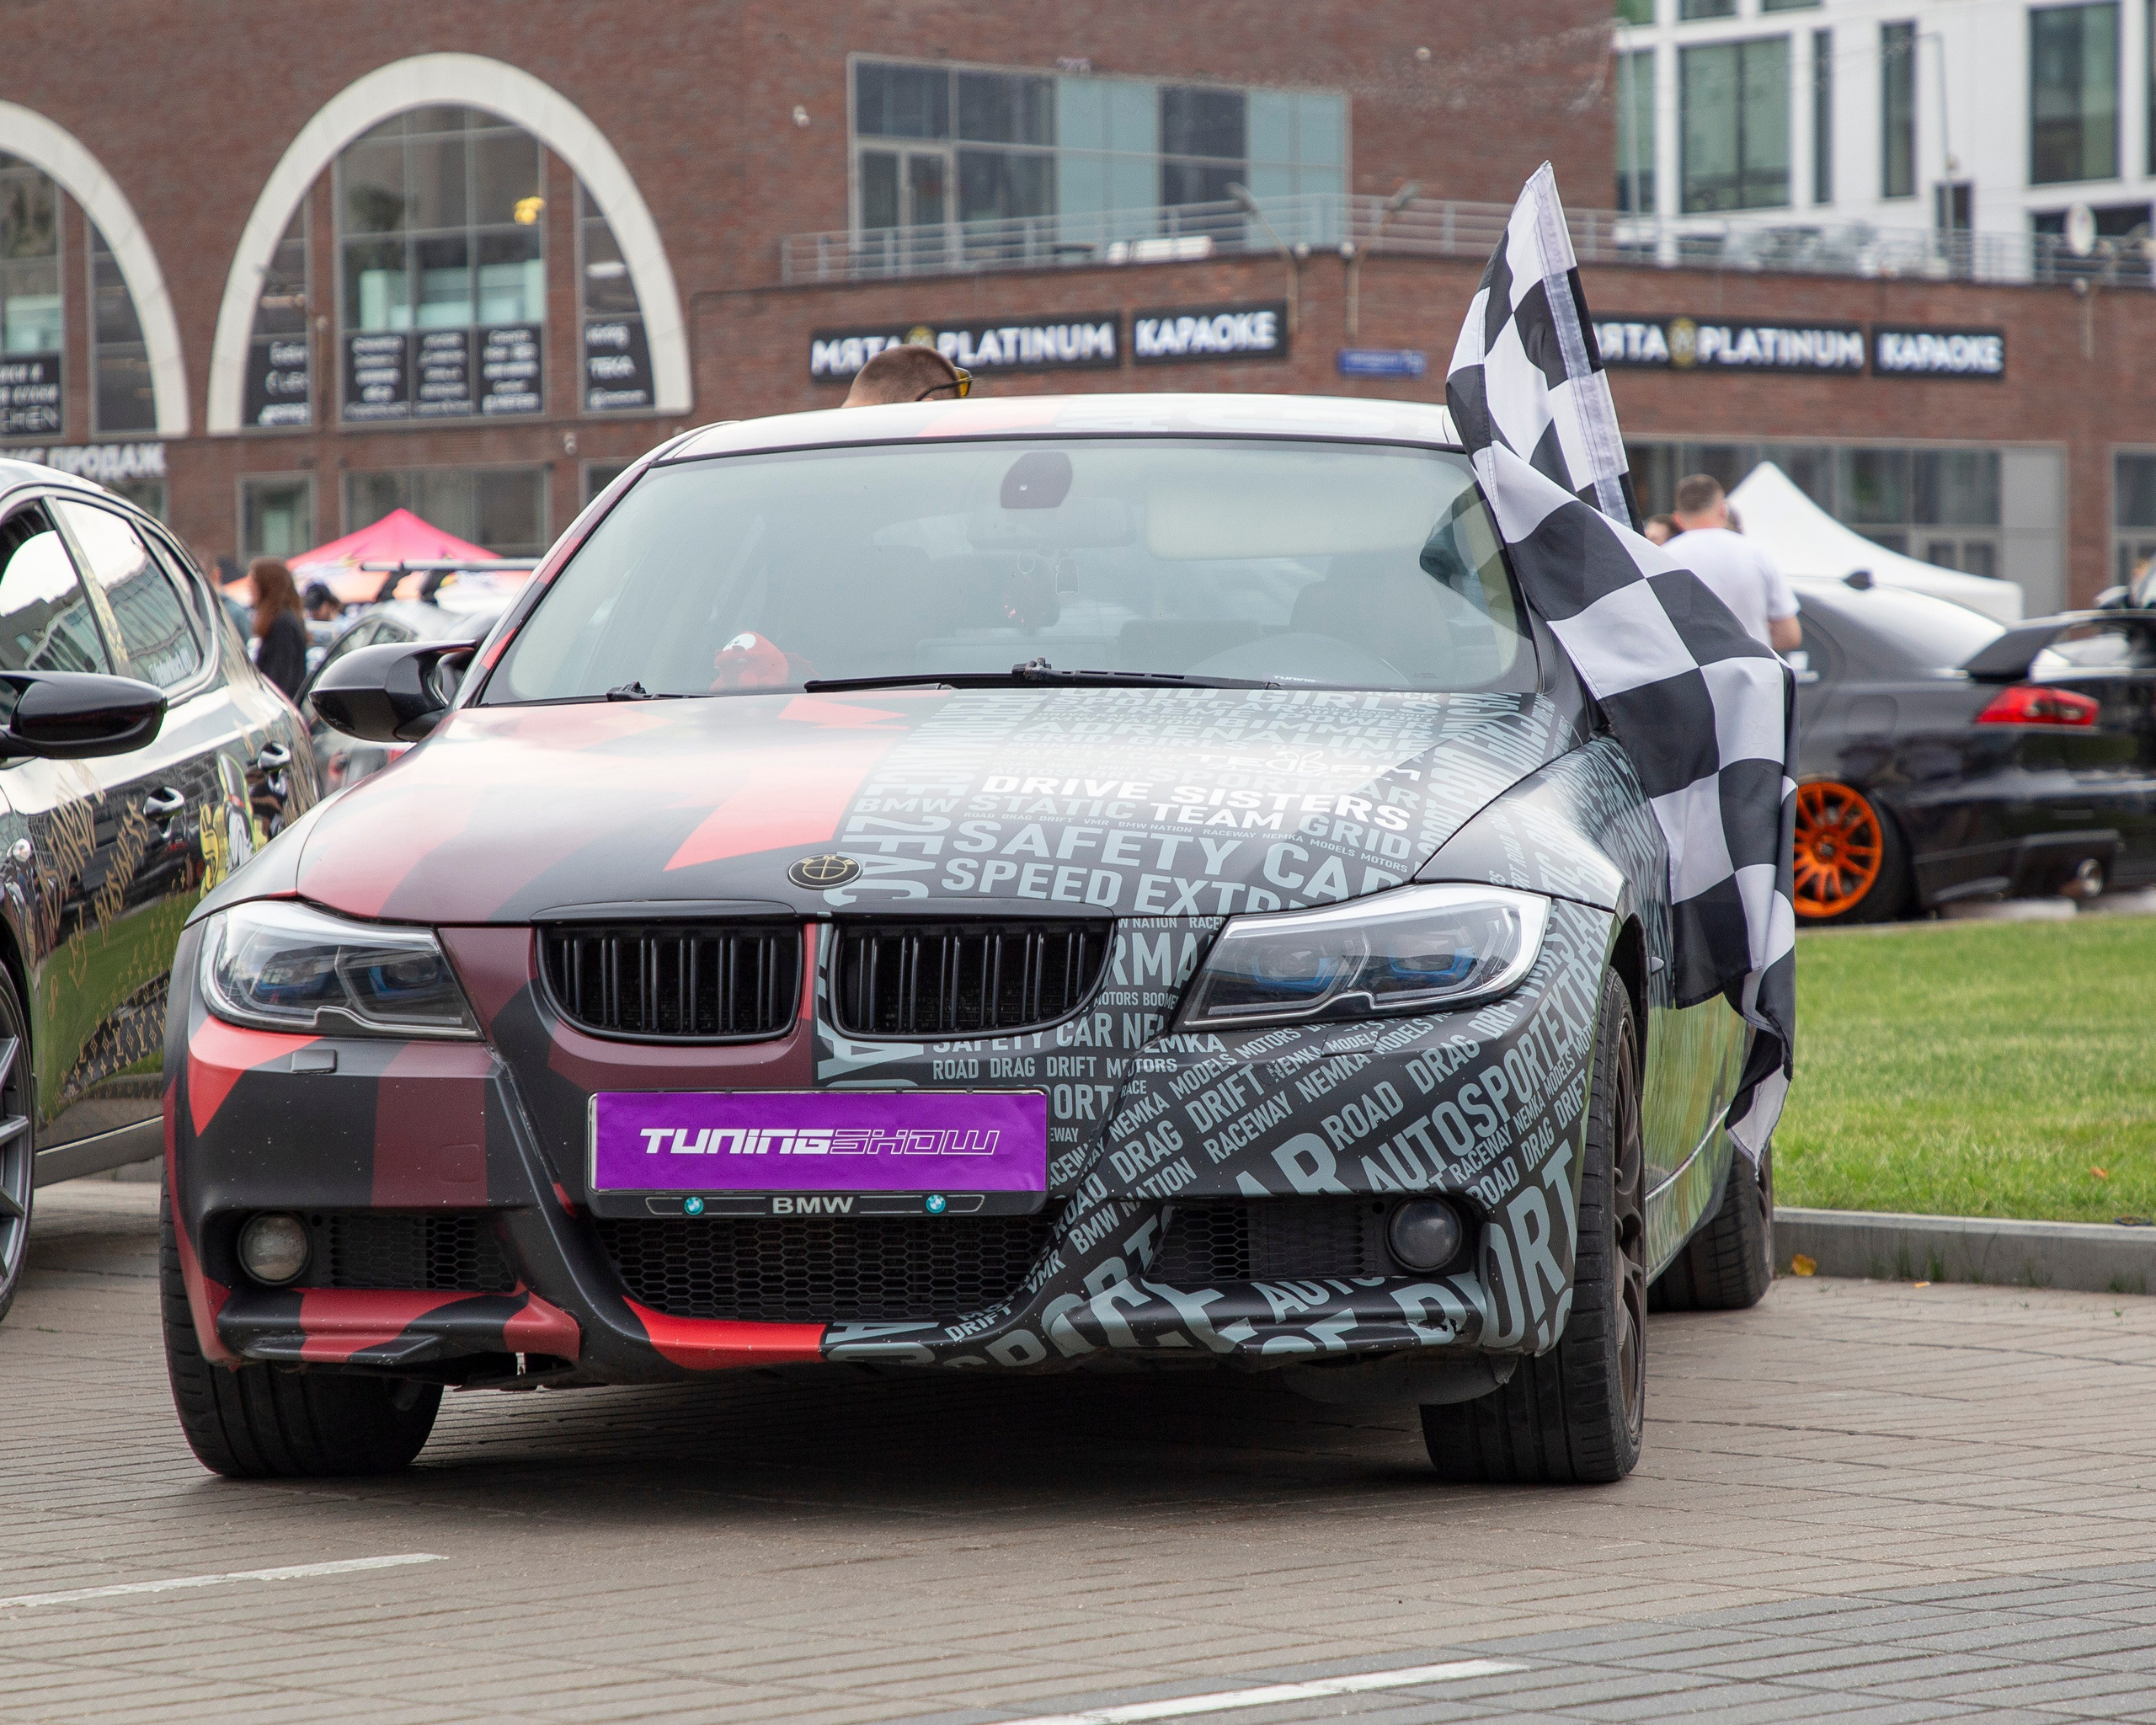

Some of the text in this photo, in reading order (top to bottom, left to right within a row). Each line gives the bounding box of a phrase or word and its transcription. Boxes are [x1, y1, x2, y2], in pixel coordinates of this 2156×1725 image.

[937, 323, 1116, 367] PLATINUM
[1136, 311, 1278, 356] КАРАОКЕ
[1697, 325, 1865, 370] PLATINUM
[1879, 333, 2003, 372] КАРАОКЕ
[47, 442, 166, 482] ПРОДАЖ
[1043, 704, 1433, 729] EXTREME POWER
[1051, 697, 1298, 713] SPORTCAR
[1246, 689, 1442, 715] GIRLS
[1353, 692, 1440, 702] RACK
[1021, 722, 1434, 751] ADRENALINE
[1106, 717, 1202, 725] NATION
[1214, 718, 1433, 739] BIMMER
[1012, 733, 1113, 745] GRID
[1128, 735, 1250, 751] GIRLS
[981, 775, 1411, 831] DRIVE SISTERS
[988, 766, 1139, 781] AUTOSPORT
[1145, 767, 1421, 809] SPORTCAR
[852, 794, 1410, 860] BMW STATIC TEAM GRID
[1083, 818, 1109, 826] VMR
[1118, 820, 1147, 830] BMW
[1150, 824, 1193, 833] NATION
[1203, 828, 1257, 839] RACEWAY
[1262, 833, 1304, 843] NEMKA
[1310, 839, 1356, 857] MODELS
[1361, 852, 1408, 873] MOTORS
[953, 820, 1243, 875] SAFETY
[941, 858, 1308, 916] SPEED EXTR
[1132, 917, 1177, 928] NATION
[1189, 916, 1225, 930] RACE
[1094, 991, 1179, 1009] MOTORS BOOME
[1055, 1012, 1113, 1049] CAR
[1326, 1030, 1380, 1053] MODELS
[1373, 1017, 1435, 1055] MODELS
[933, 1055, 1177, 1079] ROAD DRAG DRIFT MOTORS
[1169, 1027, 1301, 1101] MODELS MOTORS
[1267, 1044, 1326, 1083] NEMKA
[1321, 998, 1524, 1151] ROAD DRAG DRIFT
[1121, 1080, 1147, 1097] RACE
[1203, 1053, 1372, 1164] RACEWAY NEMKA
[1361, 1014, 1554, 1193] AUTOSPORT
[1108, 1063, 1265, 1184] DRAG DRIFT
[1109, 1092, 1171, 1142] NEMKA
[1449, 1122, 1513, 1186] RACEWAY
[1513, 1091, 1546, 1135] NEMKA
[1544, 1049, 1577, 1100] MODELS
[640, 1128, 1000, 1155] TUNINGSHOW
[1465, 1068, 1588, 1210] ROAD DRAG DRIFT
[773, 1197, 854, 1215] BMW
[1053, 1172, 1108, 1240] ROAD
[1068, 1156, 1198, 1255] BMW NATION
[1027, 1249, 1066, 1295] VMR
[945, 1305, 1012, 1343] DRIFT
